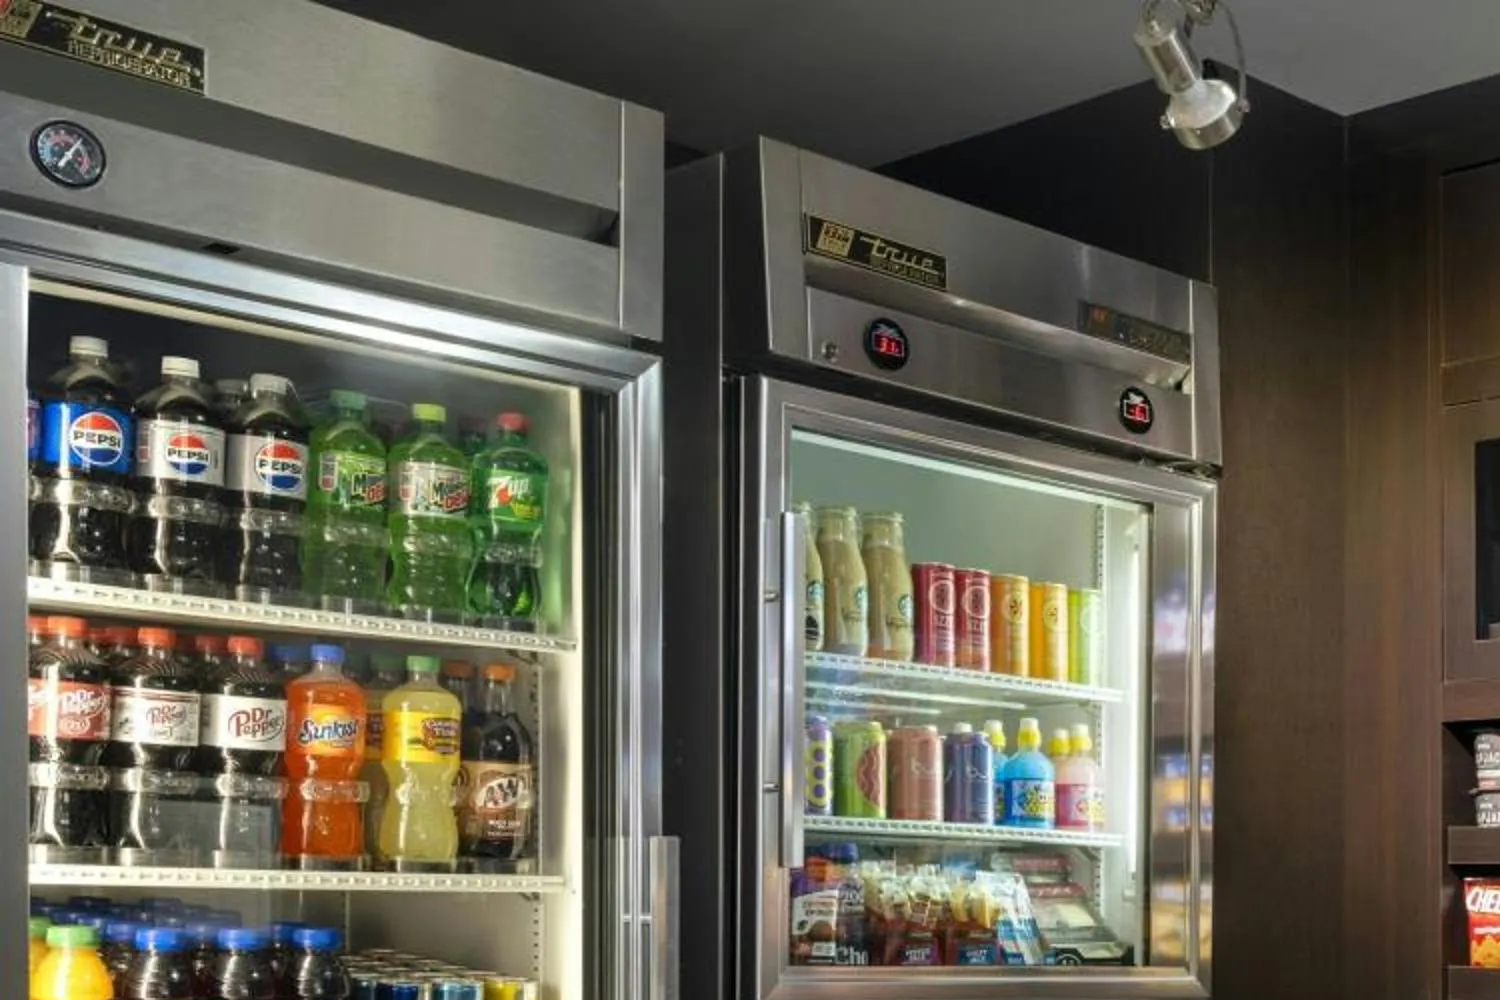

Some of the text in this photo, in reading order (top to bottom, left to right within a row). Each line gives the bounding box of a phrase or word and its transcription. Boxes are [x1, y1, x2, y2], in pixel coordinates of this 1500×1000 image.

[73, 430, 121, 448] PEPSI
[167, 447, 209, 462] PEPSI
[258, 459, 301, 475] PEPS
[251, 706, 273, 722] Dr
[299, 719, 358, 745] Sunkist
